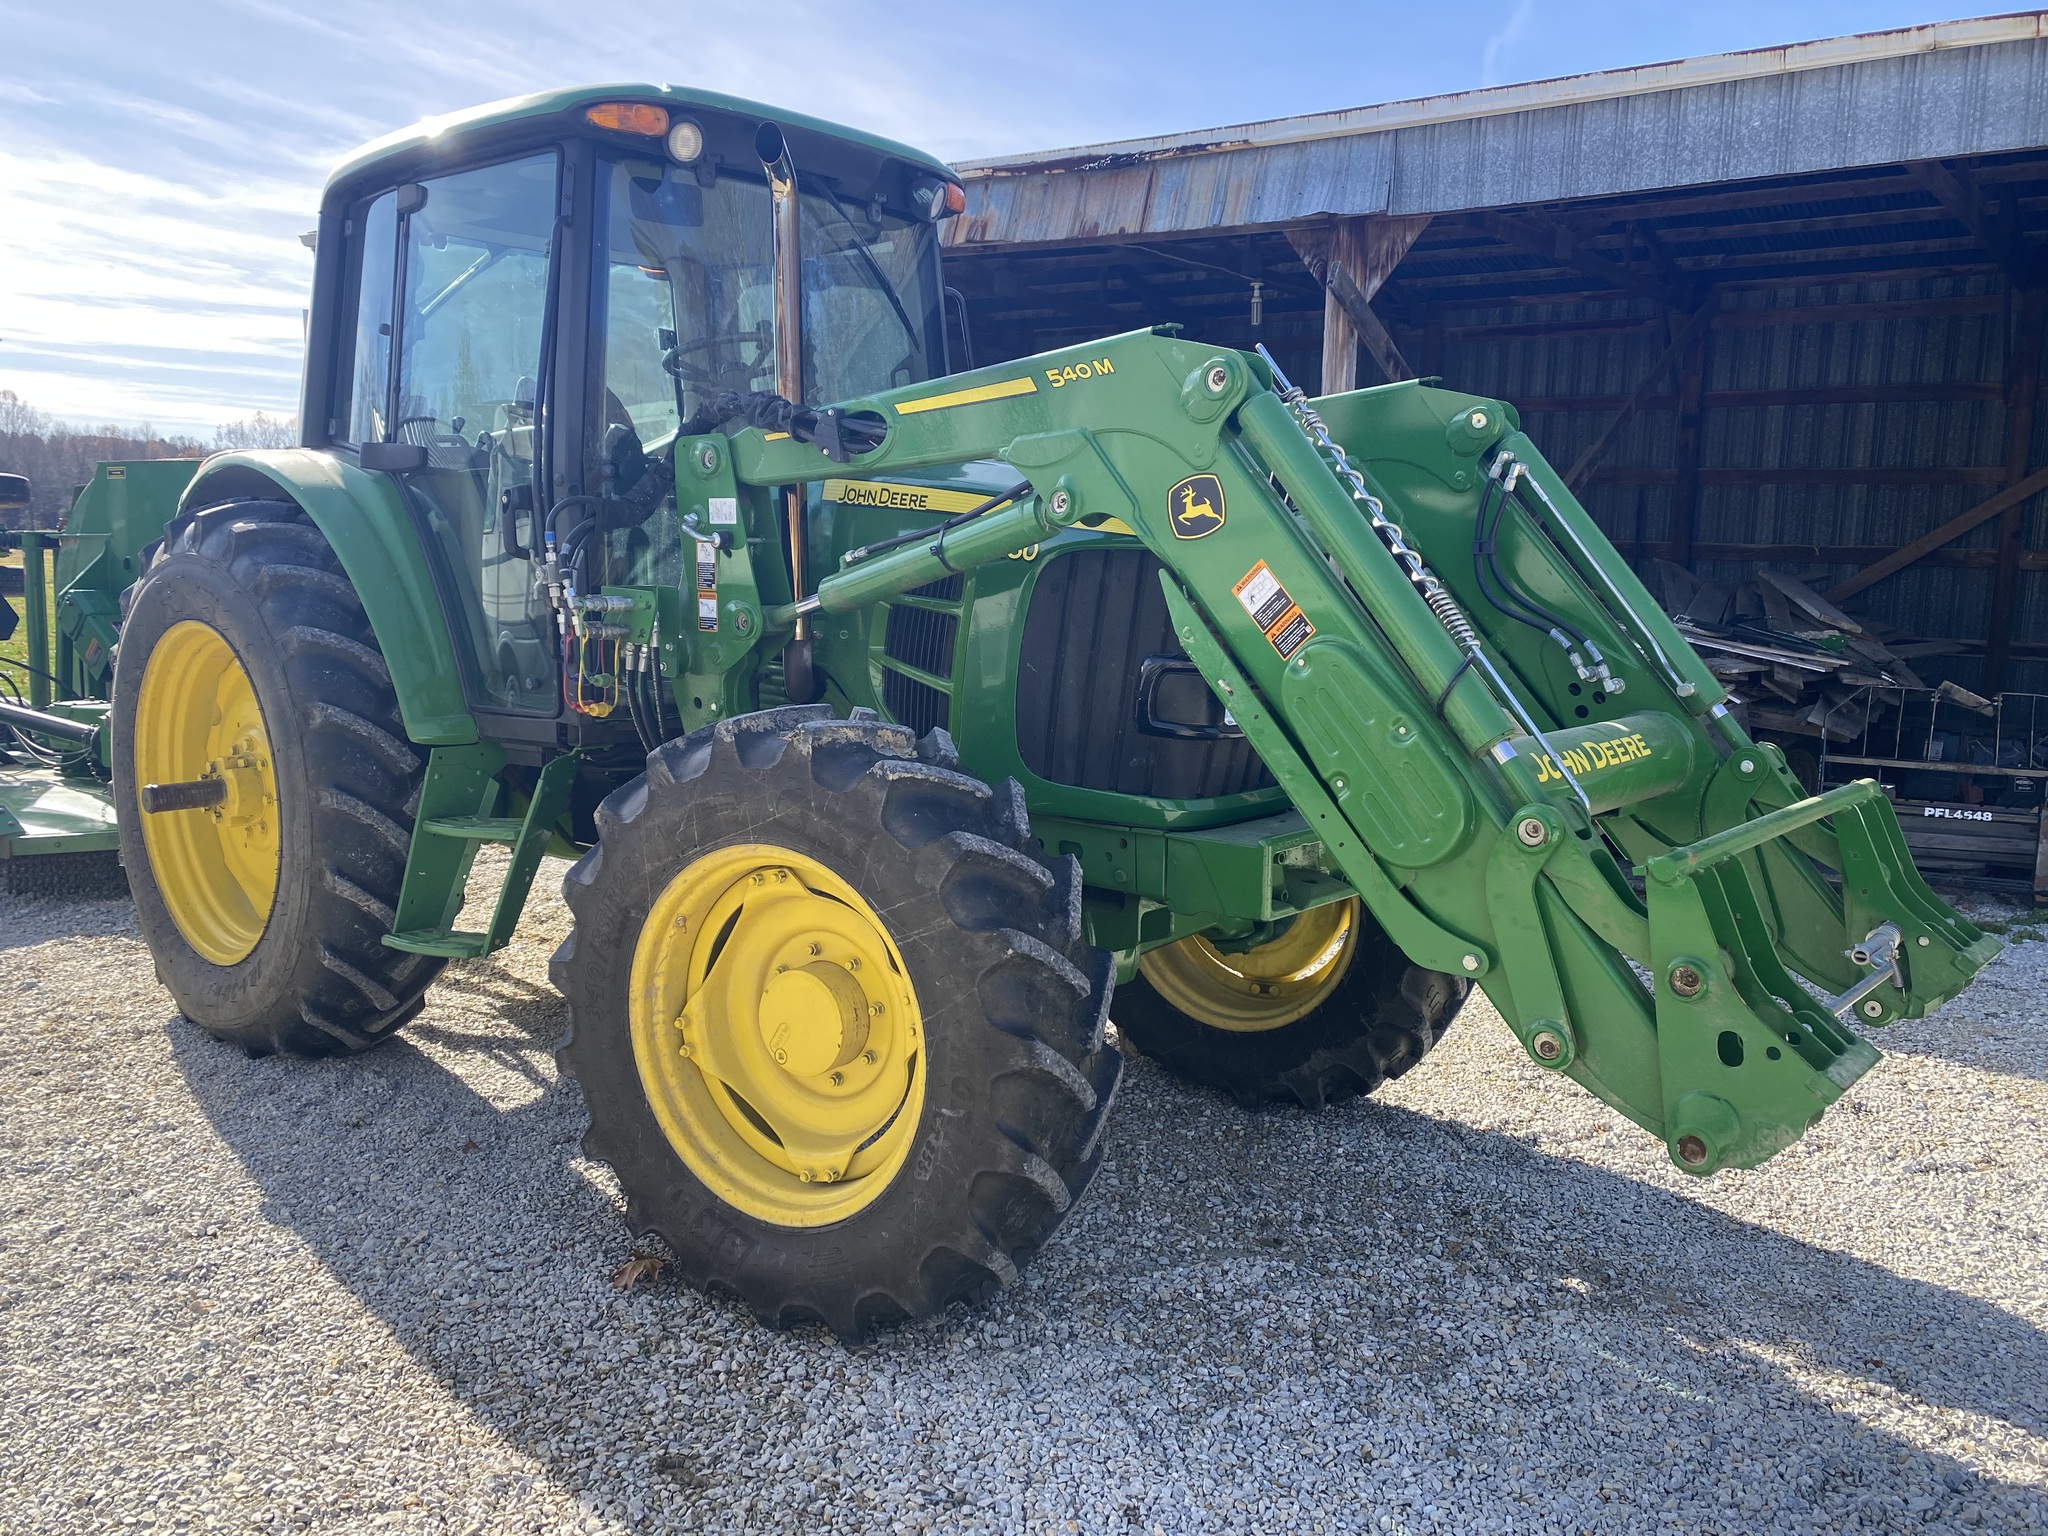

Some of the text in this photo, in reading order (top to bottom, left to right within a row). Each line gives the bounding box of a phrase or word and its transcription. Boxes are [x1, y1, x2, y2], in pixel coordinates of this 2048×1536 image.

[1045, 357, 1116, 388] 540 M
[837, 484, 929, 510] JOHN DEERE
[1241, 564, 1262, 586] WARNING
[1276, 611, 1298, 632] WARNING
[1529, 733, 1652, 783] JOHN DEERE
